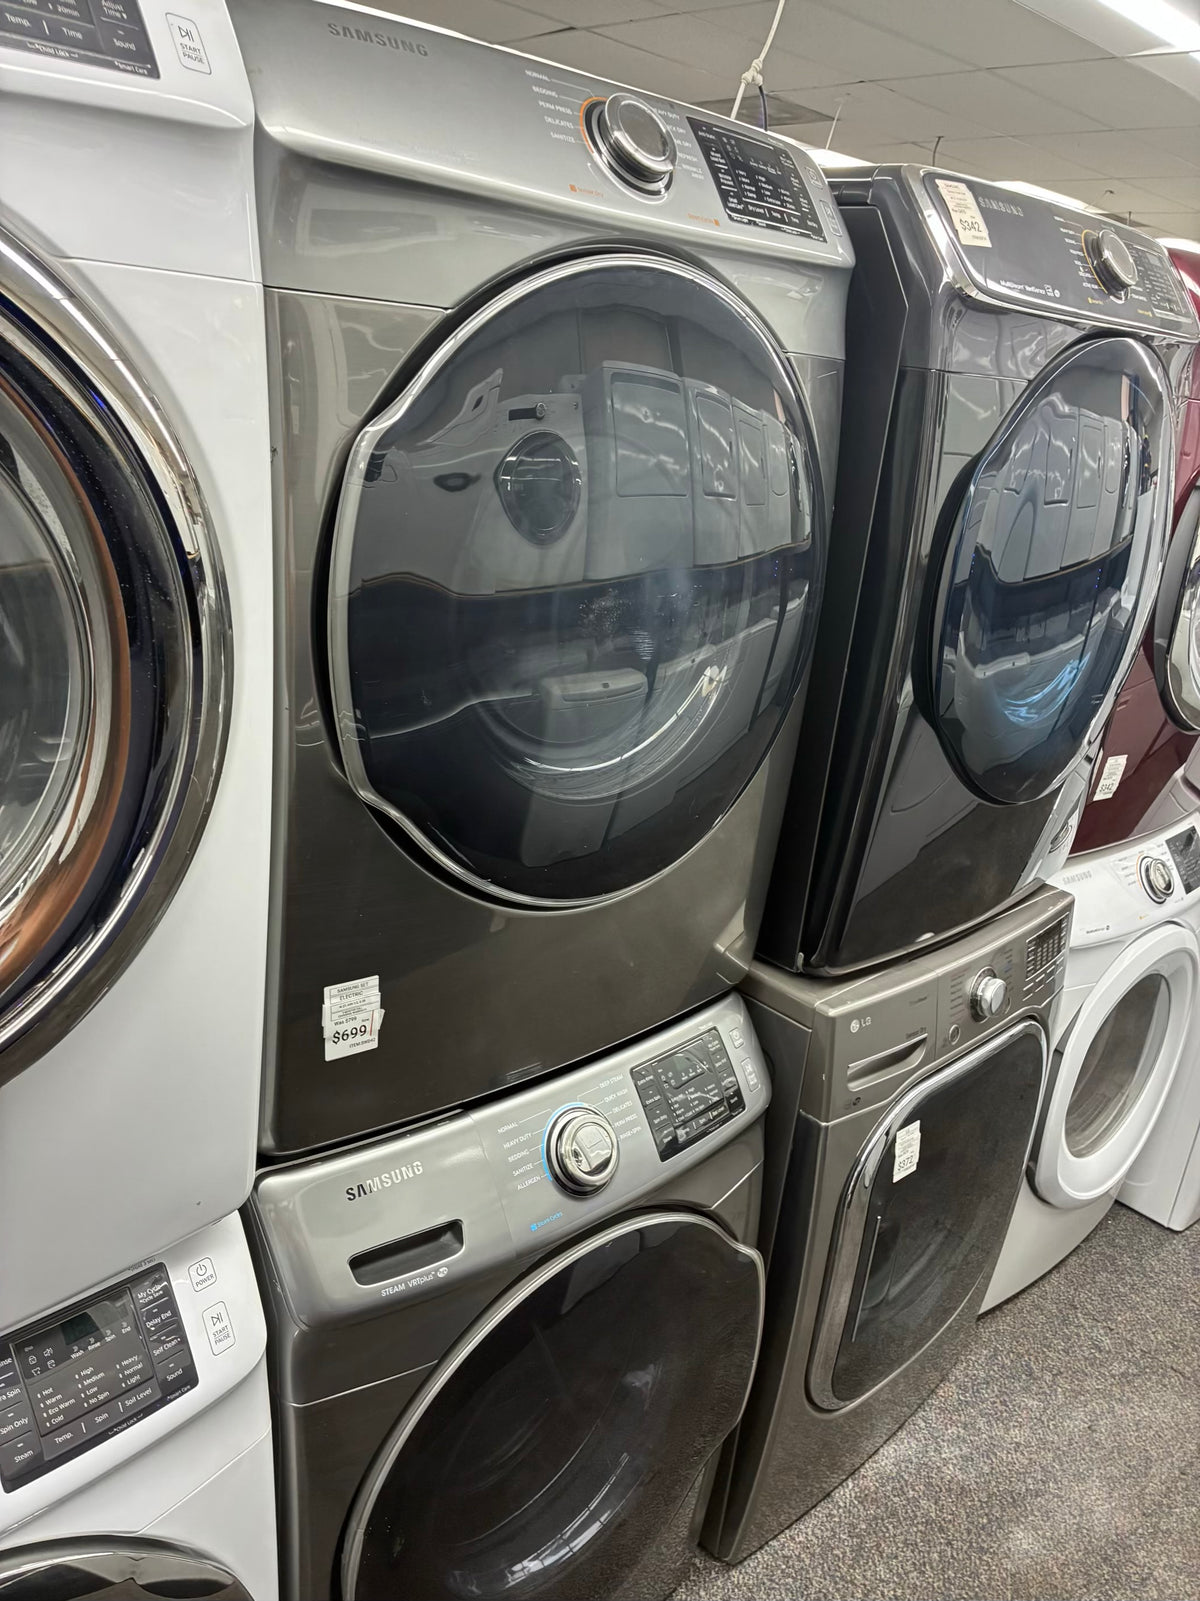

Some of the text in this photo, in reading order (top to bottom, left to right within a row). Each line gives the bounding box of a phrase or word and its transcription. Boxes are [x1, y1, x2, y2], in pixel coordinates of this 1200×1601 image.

[61, 26, 83, 40] Time
[113, 38, 136, 51] Sound
[327, 23, 428, 57] SAMSUNG
[180, 43, 201, 54] START
[183, 52, 206, 65] PAUSE
[977, 196, 1024, 217] SAMSUNG
[959, 218, 982, 233] $342
[337, 984, 360, 994] SAMSUNG
[340, 990, 364, 1001] ELECTRIC
[861, 1016, 872, 1028] LG
[332, 1024, 367, 1045] $699
[497, 1121, 519, 1134] NORMAL
[503, 1132, 532, 1149] HEAVY DUTY
[507, 1148, 529, 1163] BEDDING
[512, 1162, 534, 1177] SANITIZE
[345, 1160, 423, 1202] SAMSUNG
[517, 1175, 541, 1191] ALLERGEN
[195, 1273, 215, 1288] POWER
[137, 1290, 147, 1299] My
[381, 1282, 406, 1297] STEAM
[146, 1310, 172, 1328] Delay End
[121, 1326, 132, 1334] End
[212, 1325, 229, 1338] START
[104, 1334, 116, 1343] Spin
[214, 1333, 231, 1346] PAUSE
[70, 1349, 85, 1360] Wash
[153, 1346, 163, 1356] Self
[121, 1354, 138, 1367] Heavy
[80, 1366, 95, 1377] High
[124, 1362, 144, 1376] Normal
[166, 1368, 183, 1381] Sound
[82, 1372, 105, 1386] Medium
[126, 1374, 141, 1386] Light
[7, 1387, 21, 1398] Spin
[42, 1387, 54, 1397] Hot
[86, 1386, 98, 1396] Low
[89, 1390, 110, 1405] No Spin
[124, 1388, 152, 1407] Soil Level
[45, 1394, 63, 1405] Warm
[48, 1398, 76, 1415] Eco Warm
[51, 1414, 65, 1425] Cold
[94, 1412, 109, 1424] Spin
[0, 1416, 28, 1435] Spin Only
[54, 1432, 74, 1444] Temp.
[14, 1449, 34, 1463] Steam
